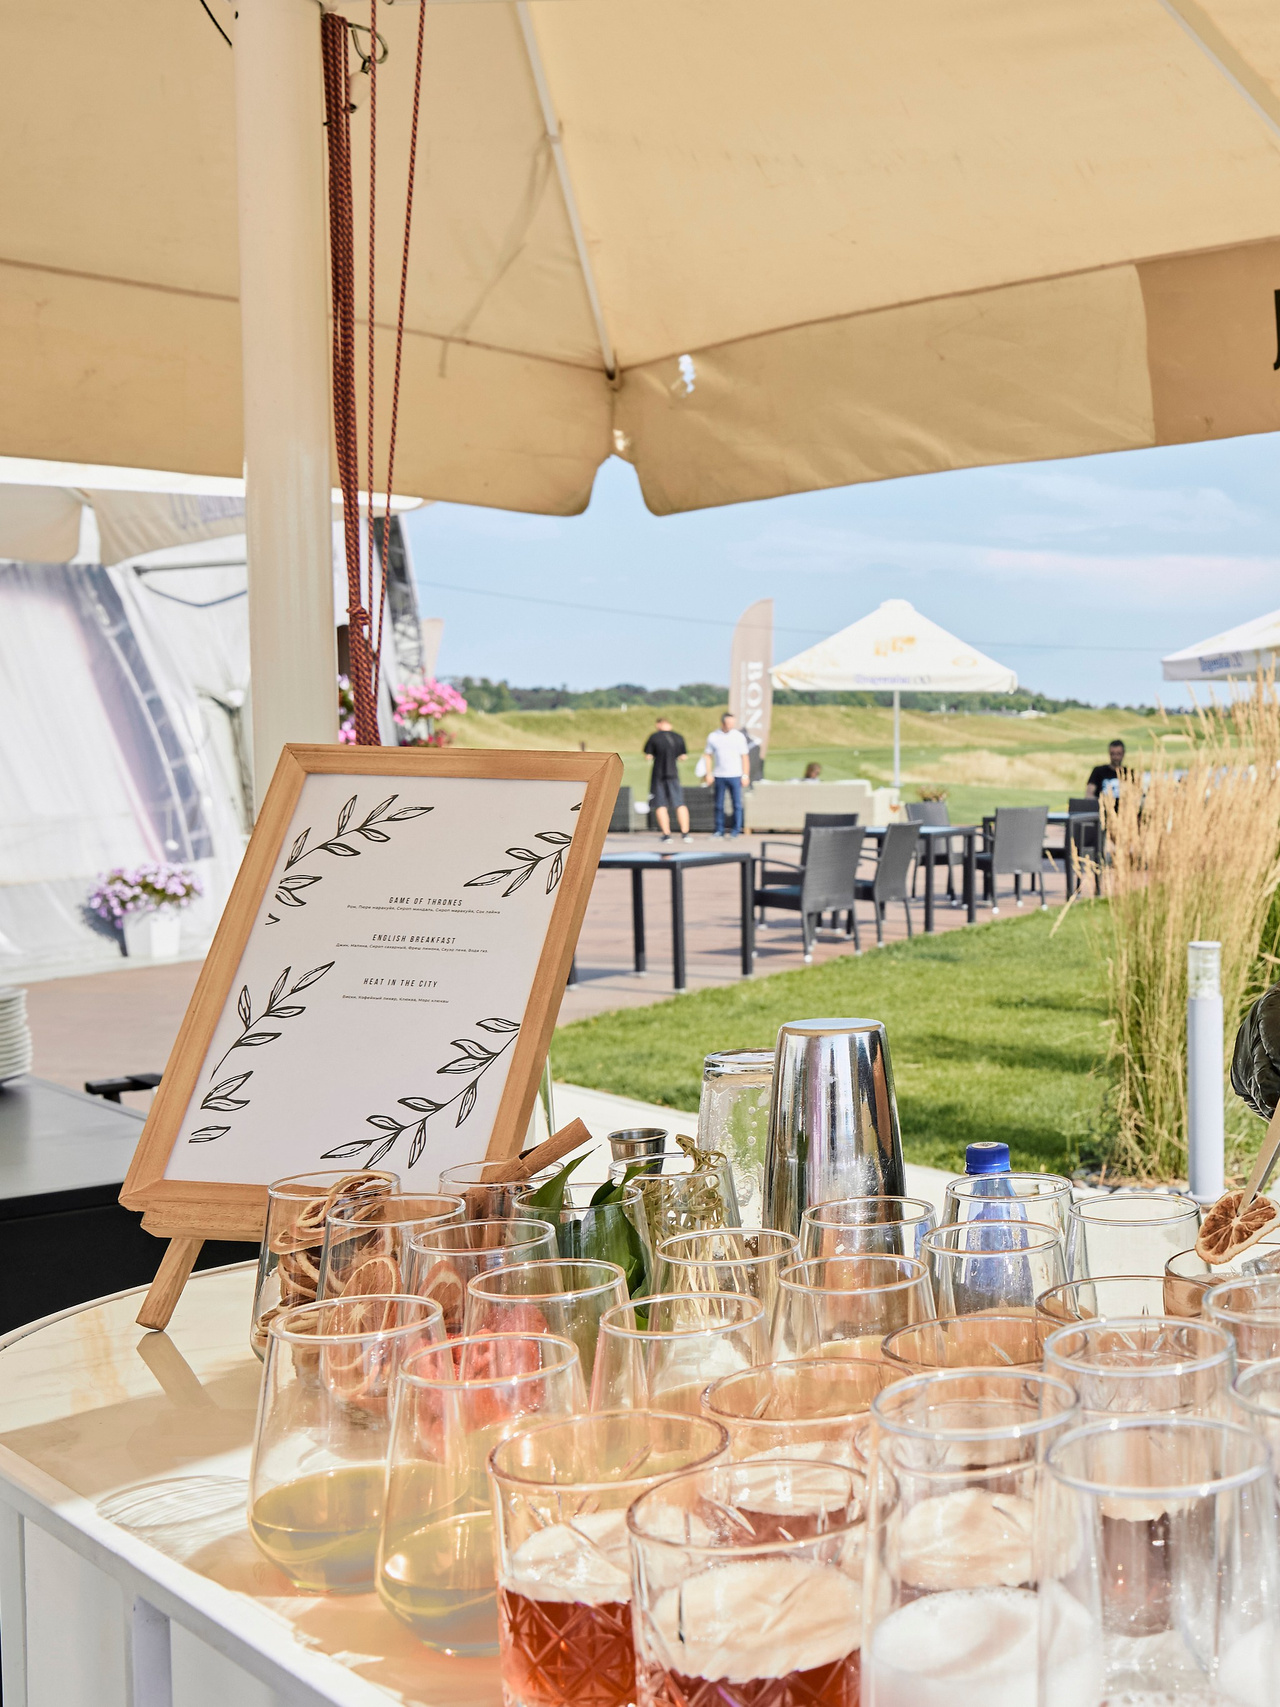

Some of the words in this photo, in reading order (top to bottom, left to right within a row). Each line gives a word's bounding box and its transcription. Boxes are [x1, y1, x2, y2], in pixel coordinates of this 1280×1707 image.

[388, 896, 410, 904] GAME
[428, 898, 462, 906] THRONES
[372, 934, 407, 942] ENGLISH
[410, 935, 456, 944] BREAKFAST
[363, 978, 384, 986] HEAT
[400, 979, 416, 987] THE
[418, 980, 438, 988] CITY
